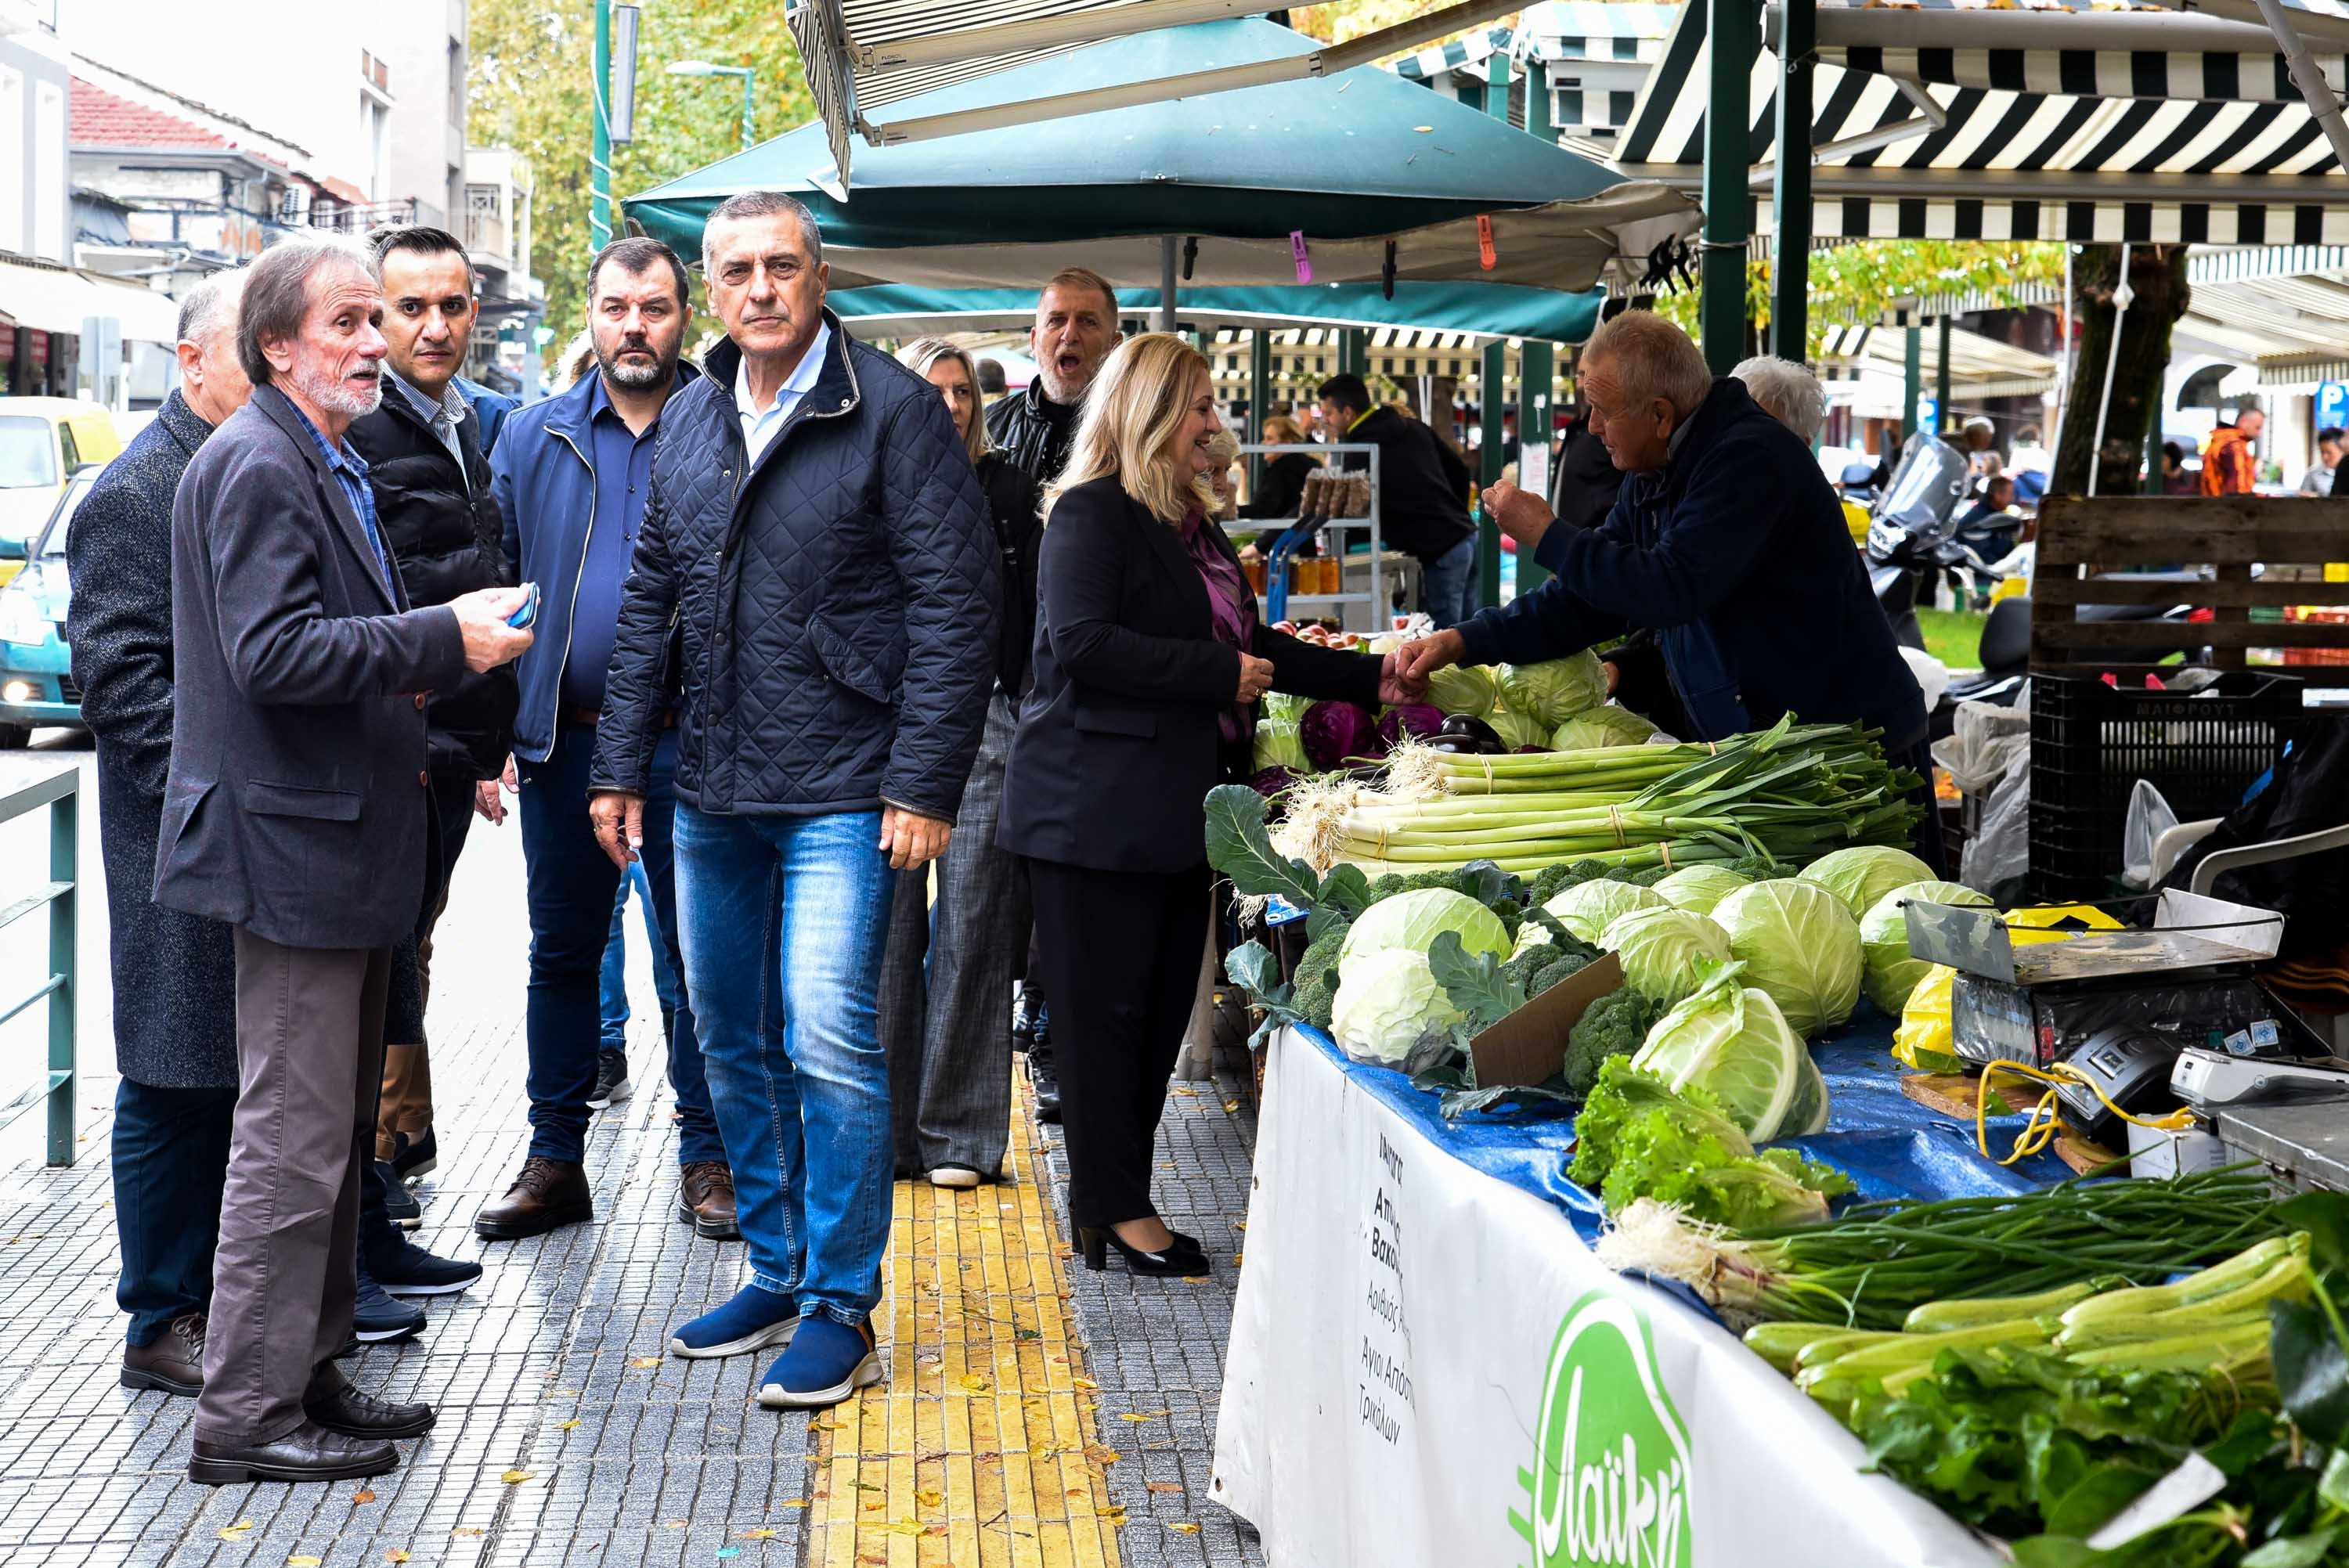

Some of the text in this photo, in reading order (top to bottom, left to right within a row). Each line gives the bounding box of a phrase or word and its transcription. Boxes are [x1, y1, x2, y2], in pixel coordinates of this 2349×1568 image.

[2322, 384, 2343, 413] P
[1366, 1279, 1398, 1332] Αριθμός
[1362, 1335, 1384, 1380] Άγιοι
[1359, 1383, 1401, 1447] Τρικάλων
